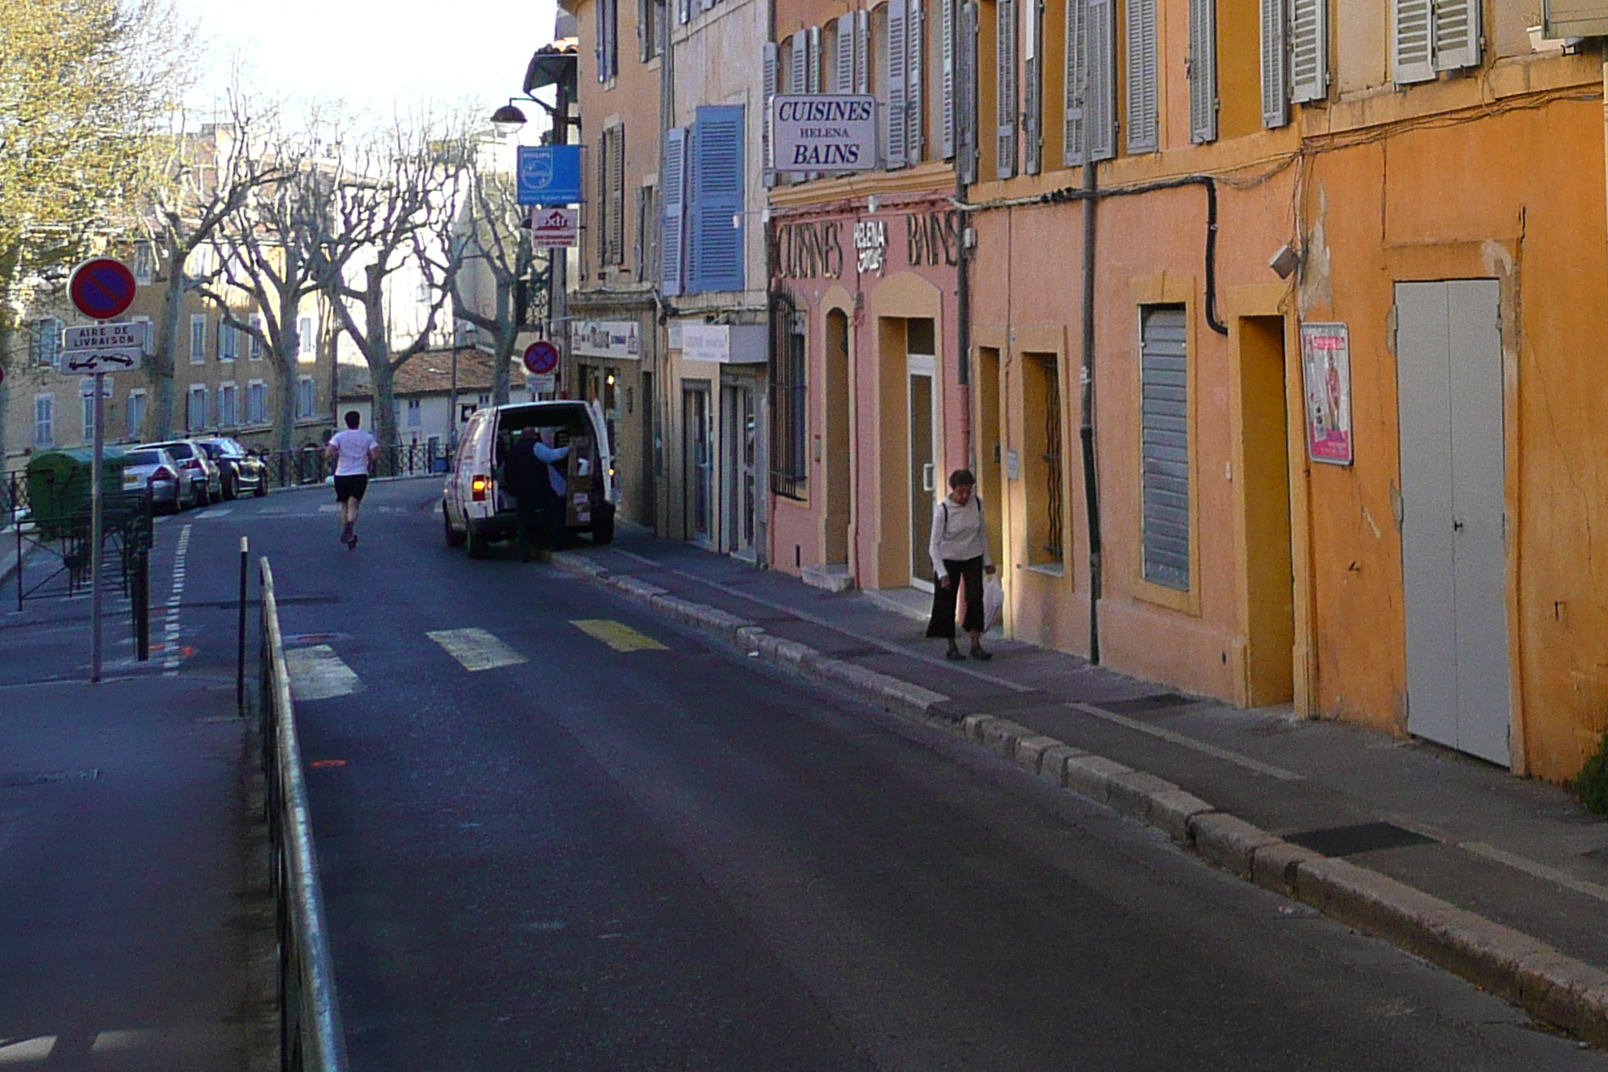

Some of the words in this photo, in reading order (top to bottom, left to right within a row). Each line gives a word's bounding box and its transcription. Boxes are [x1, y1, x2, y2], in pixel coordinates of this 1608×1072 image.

[779, 101, 871, 121] CUISINES
[801, 129, 849, 138] HELENA
[793, 144, 859, 165] BAINS
[775, 221, 843, 279] CUISINES
[79, 328, 106, 337] AIRE
[115, 326, 128, 335] DE
[74, 335, 134, 347] LIVRAISON
